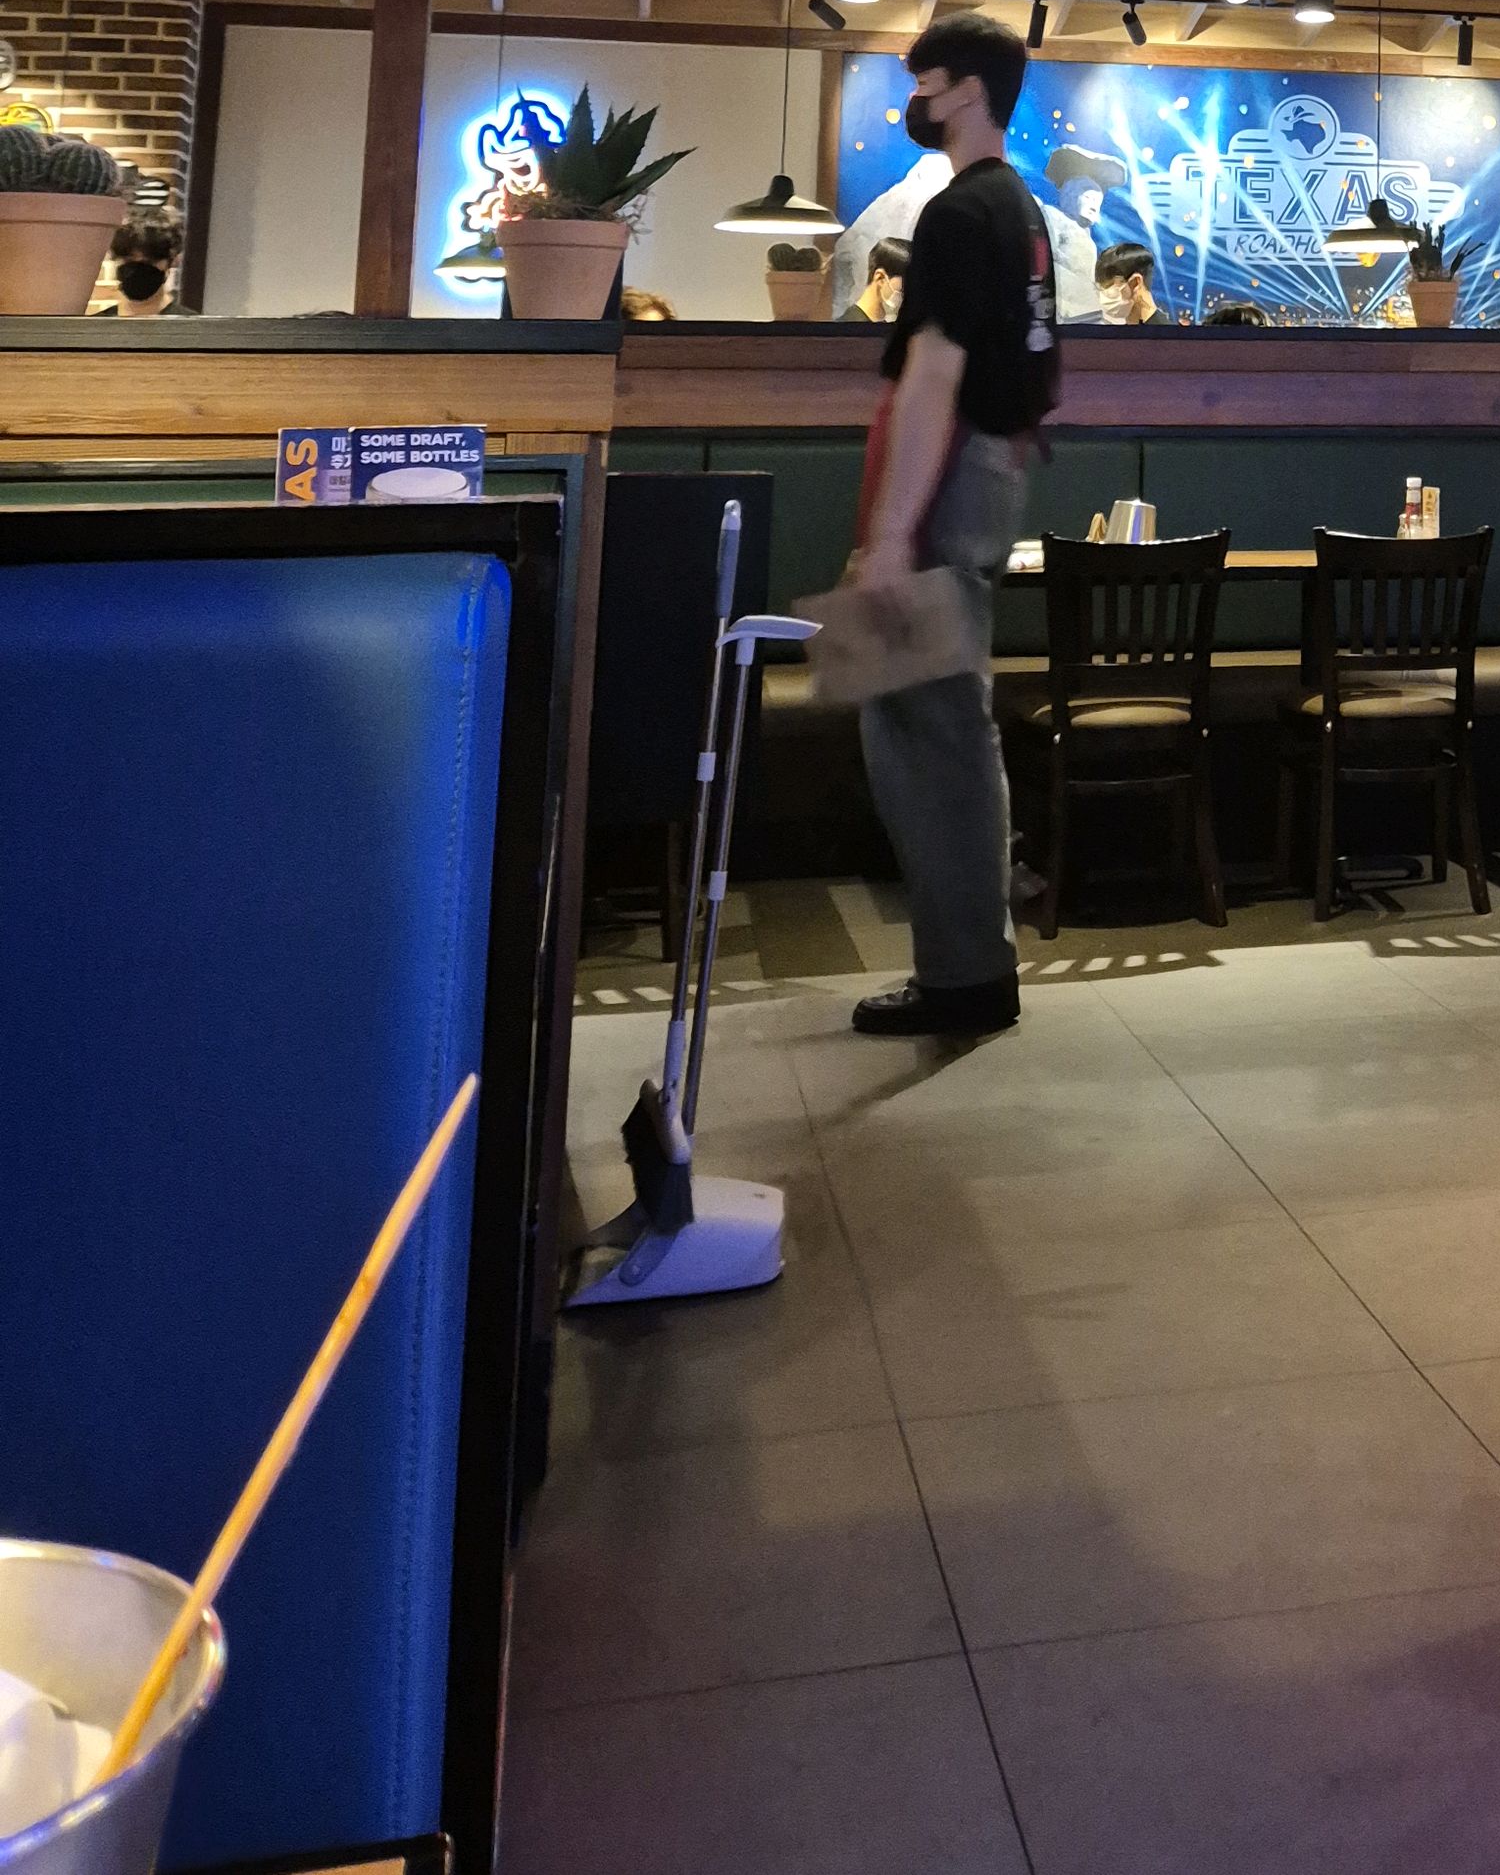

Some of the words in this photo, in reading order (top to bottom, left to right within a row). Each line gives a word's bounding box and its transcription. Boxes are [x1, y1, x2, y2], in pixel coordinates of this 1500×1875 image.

[1186, 164, 1419, 226] TEXAS
[360, 434, 405, 447] SOME
[410, 433, 466, 446] DRAFT,
[360, 451, 405, 463] SOME
[410, 450, 480, 462] BOTTLES
